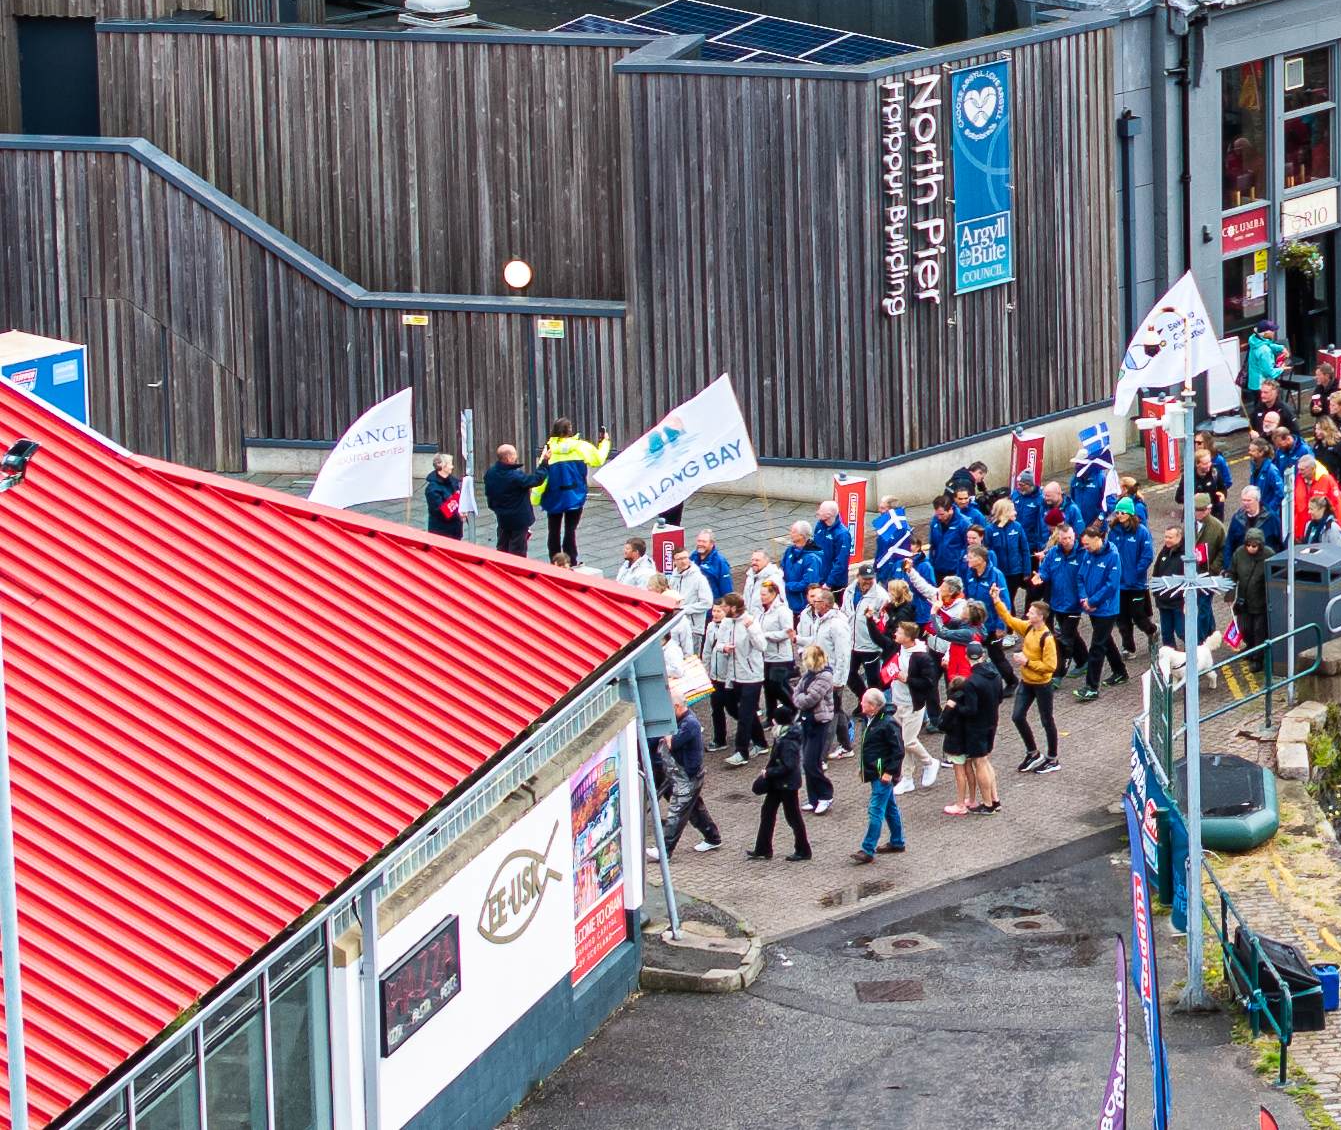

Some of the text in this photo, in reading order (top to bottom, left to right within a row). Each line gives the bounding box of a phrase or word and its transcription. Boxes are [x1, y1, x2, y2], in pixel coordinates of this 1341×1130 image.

[881, 81, 908, 316] Harbour Building
[909, 74, 945, 305] North Pier
[960, 216, 1006, 248] Argyll
[971, 243, 1006, 267] Bute
[962, 264, 1004, 284] COUNCIL
[703, 438, 742, 470] BAY
[1136, 884, 1150, 990] CLIPPER
